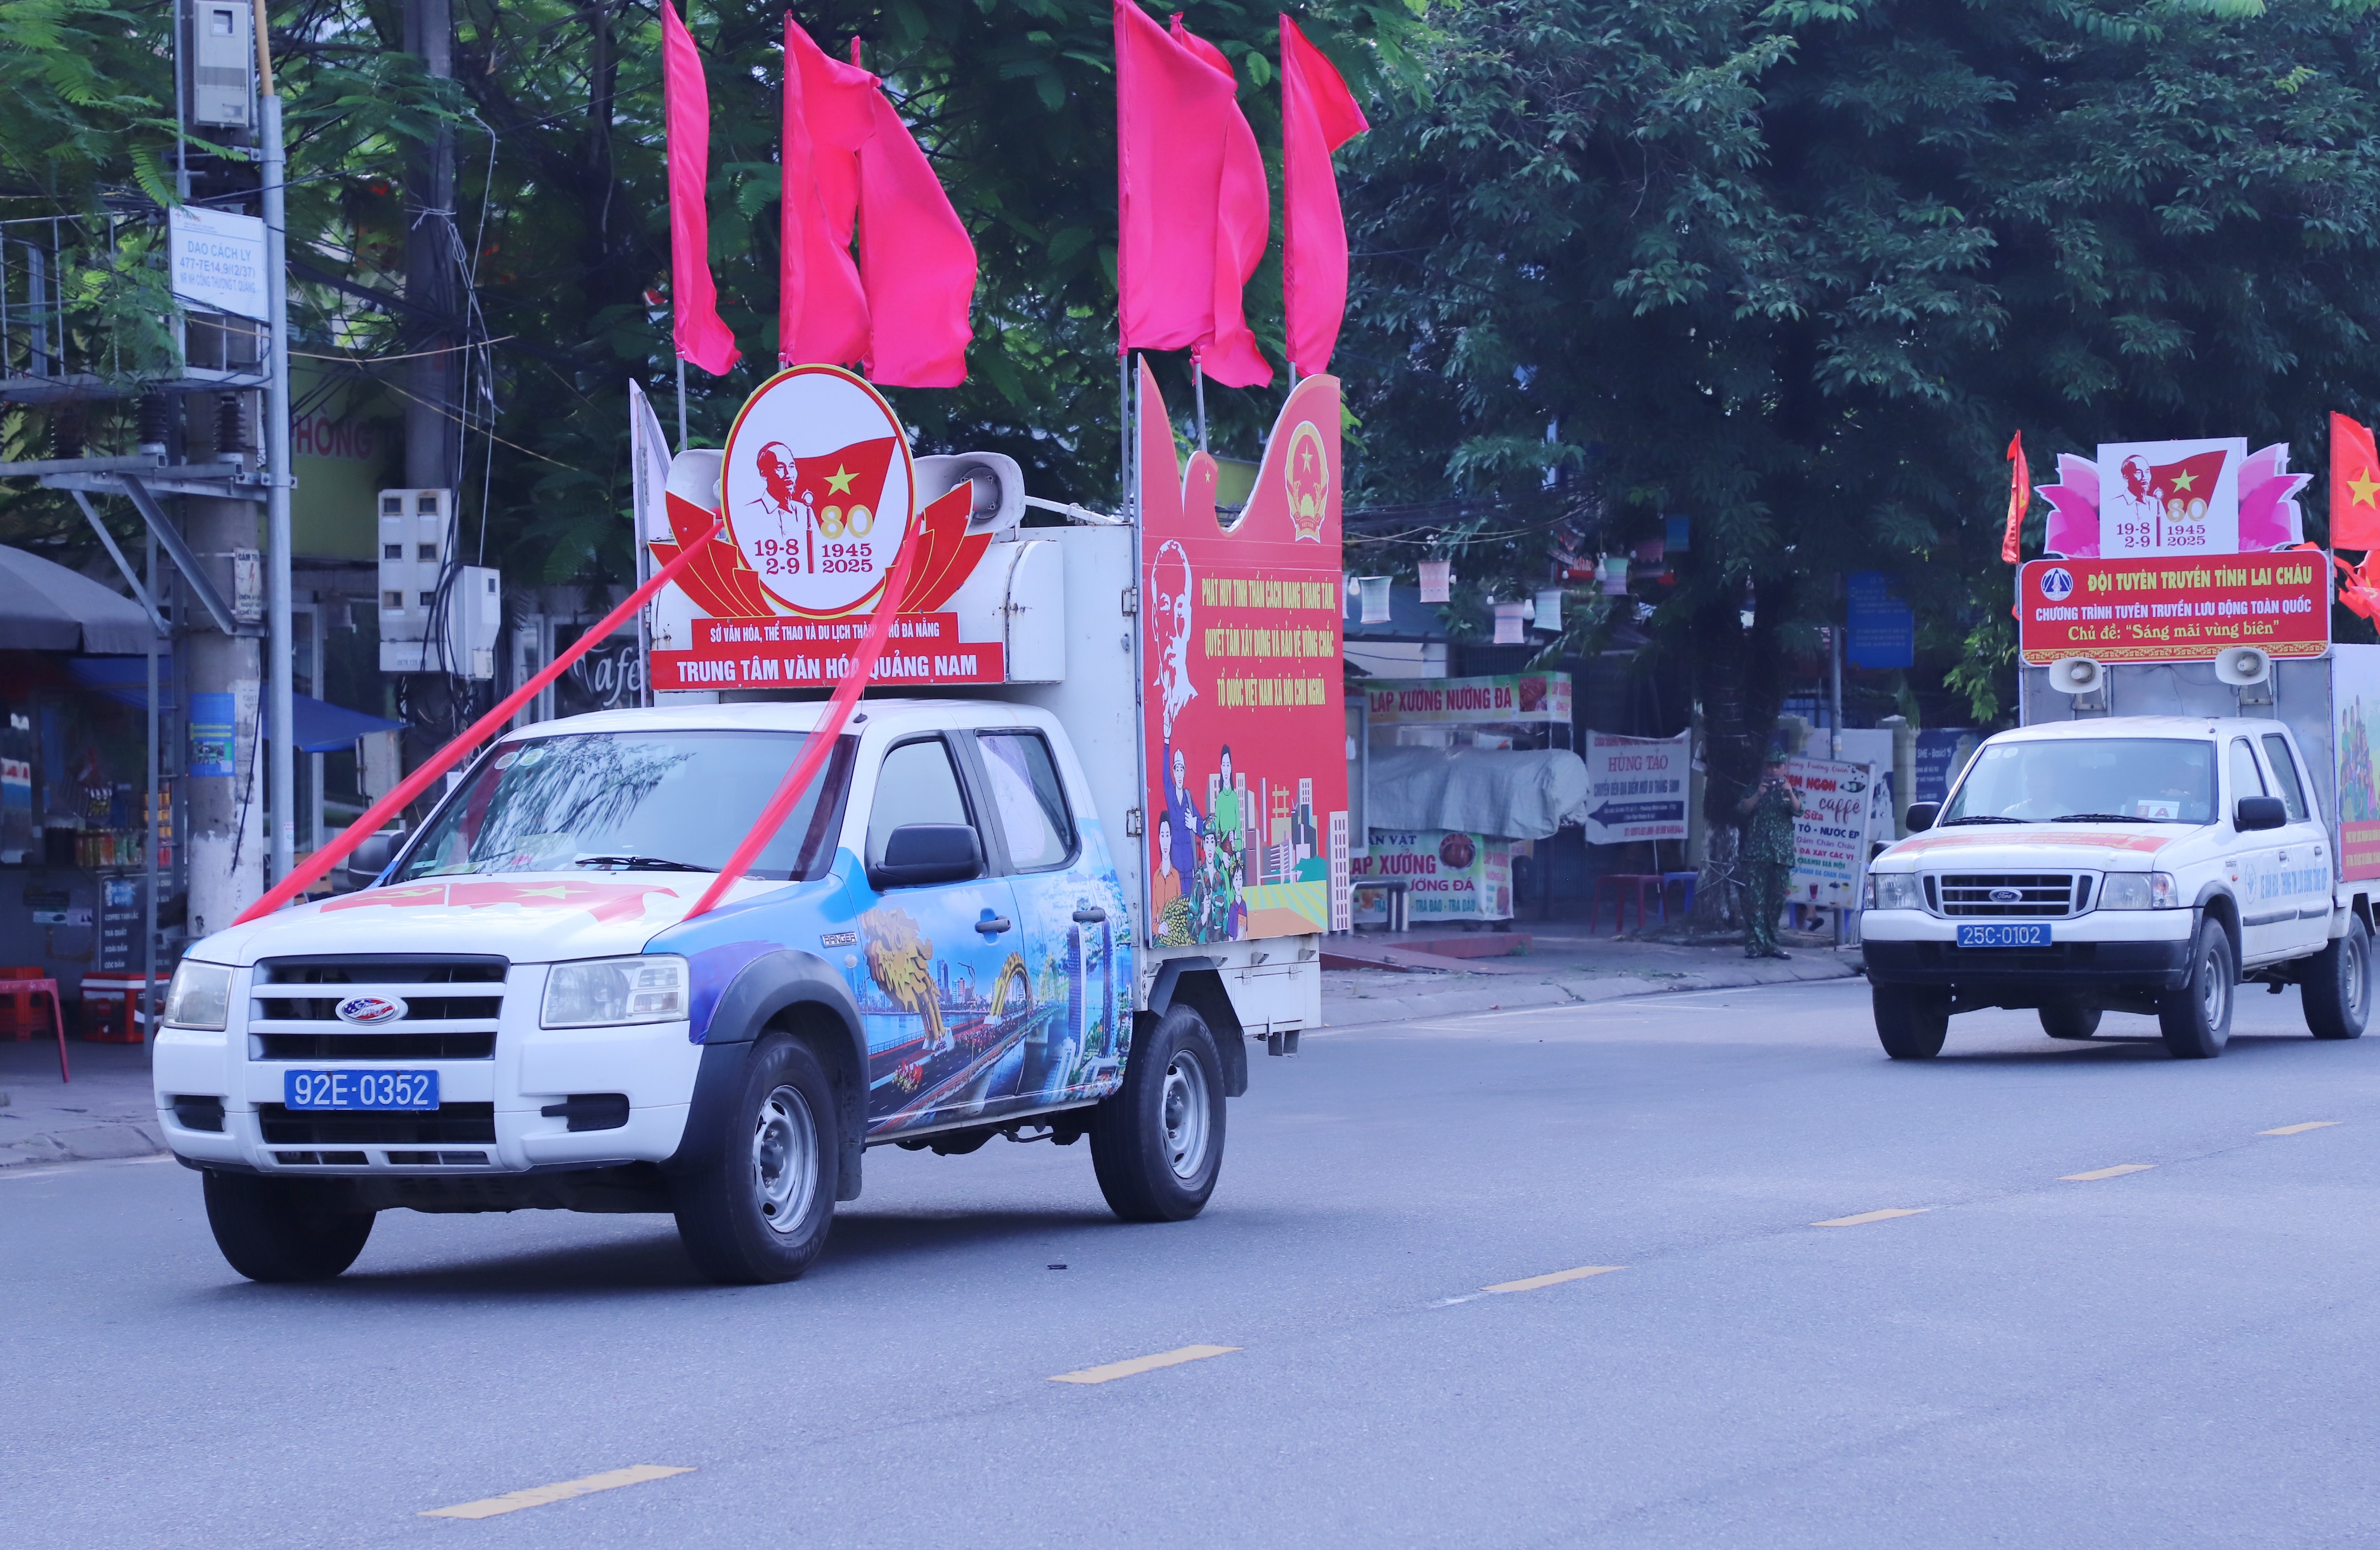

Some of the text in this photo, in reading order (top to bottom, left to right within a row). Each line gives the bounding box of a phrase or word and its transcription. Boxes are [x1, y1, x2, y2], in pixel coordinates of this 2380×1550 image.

[188, 240, 251, 261] DAO CÁCH LY
[2167, 497, 2207, 522] 80
[820, 504, 873, 539] 80
[2117, 523, 2205, 535] 19-8 1945
[754, 539, 872, 557] 19-8 1945
[2125, 536, 2205, 548] 2-9 2025
[766, 558, 872, 574] 2-9 2025
[2088, 563, 2312, 596] ĐỘI TUYÊN TRUYỀN TỈNH LAI CHÂU
[1202, 570, 1335, 614] PHÁT HUY TINH THẦN CÁCH MẠNG THÁNG TÁM,
[2036, 594, 2311, 622] CHƯƠNG TRÌNH TUYÊN TRUYỀN LƯU ĐỘNG TOÀN QUỐC
[710, 623, 721, 642] SỞ
[723, 624, 740, 642] VĂN
[743, 624, 762, 643] HÓA,
[764, 620, 780, 641] THỂ
[782, 626, 803, 640] THAO
[805, 622, 816, 640] VÀ
[818, 625, 829, 639] DU
[832, 624, 850, 643] LỊCH
[888, 618, 899, 638] HỐ
[902, 620, 913, 637] ĐÀ
[916, 617, 939, 637] NẴNG
[2068, 625, 2096, 640] Chủ
[2100, 623, 2120, 639] đề:
[2174, 624, 2200, 637] mãi
[2204, 623, 2239, 638] vùng
[1205, 619, 1334, 663] QUYẾT TÂM XÂY DỰNG VÀ BẢO VỆ VỮNG CHẮC
[677, 660, 736, 682] TRUNG
[740, 655, 779, 680] TÂM
[784, 655, 820, 679] VĂN
[869, 650, 929, 680] QUẢNG
[935, 655, 977, 676] NAM
[1217, 667, 1325, 712] TỔ QUỐC VIỆT NAM XÃ HỘI CHỦ NGHĨA
[1399, 684, 1442, 712] XƯỞNG
[1446, 685, 1490, 710] NƯỚNG
[1495, 683, 1512, 708] ĐÁ
[1608, 752, 1642, 772] HÙNG
[1806, 778, 1836, 792] NGON
[2154, 807, 2170, 817] A
[1379, 848, 1436, 874] XƯỞNG
[1452, 877, 1474, 891] ĐÁ
[824, 934, 856, 945] RANGER
[1963, 926, 2041, 944] 25C-0102
[353, 1001, 385, 1016] Ford
